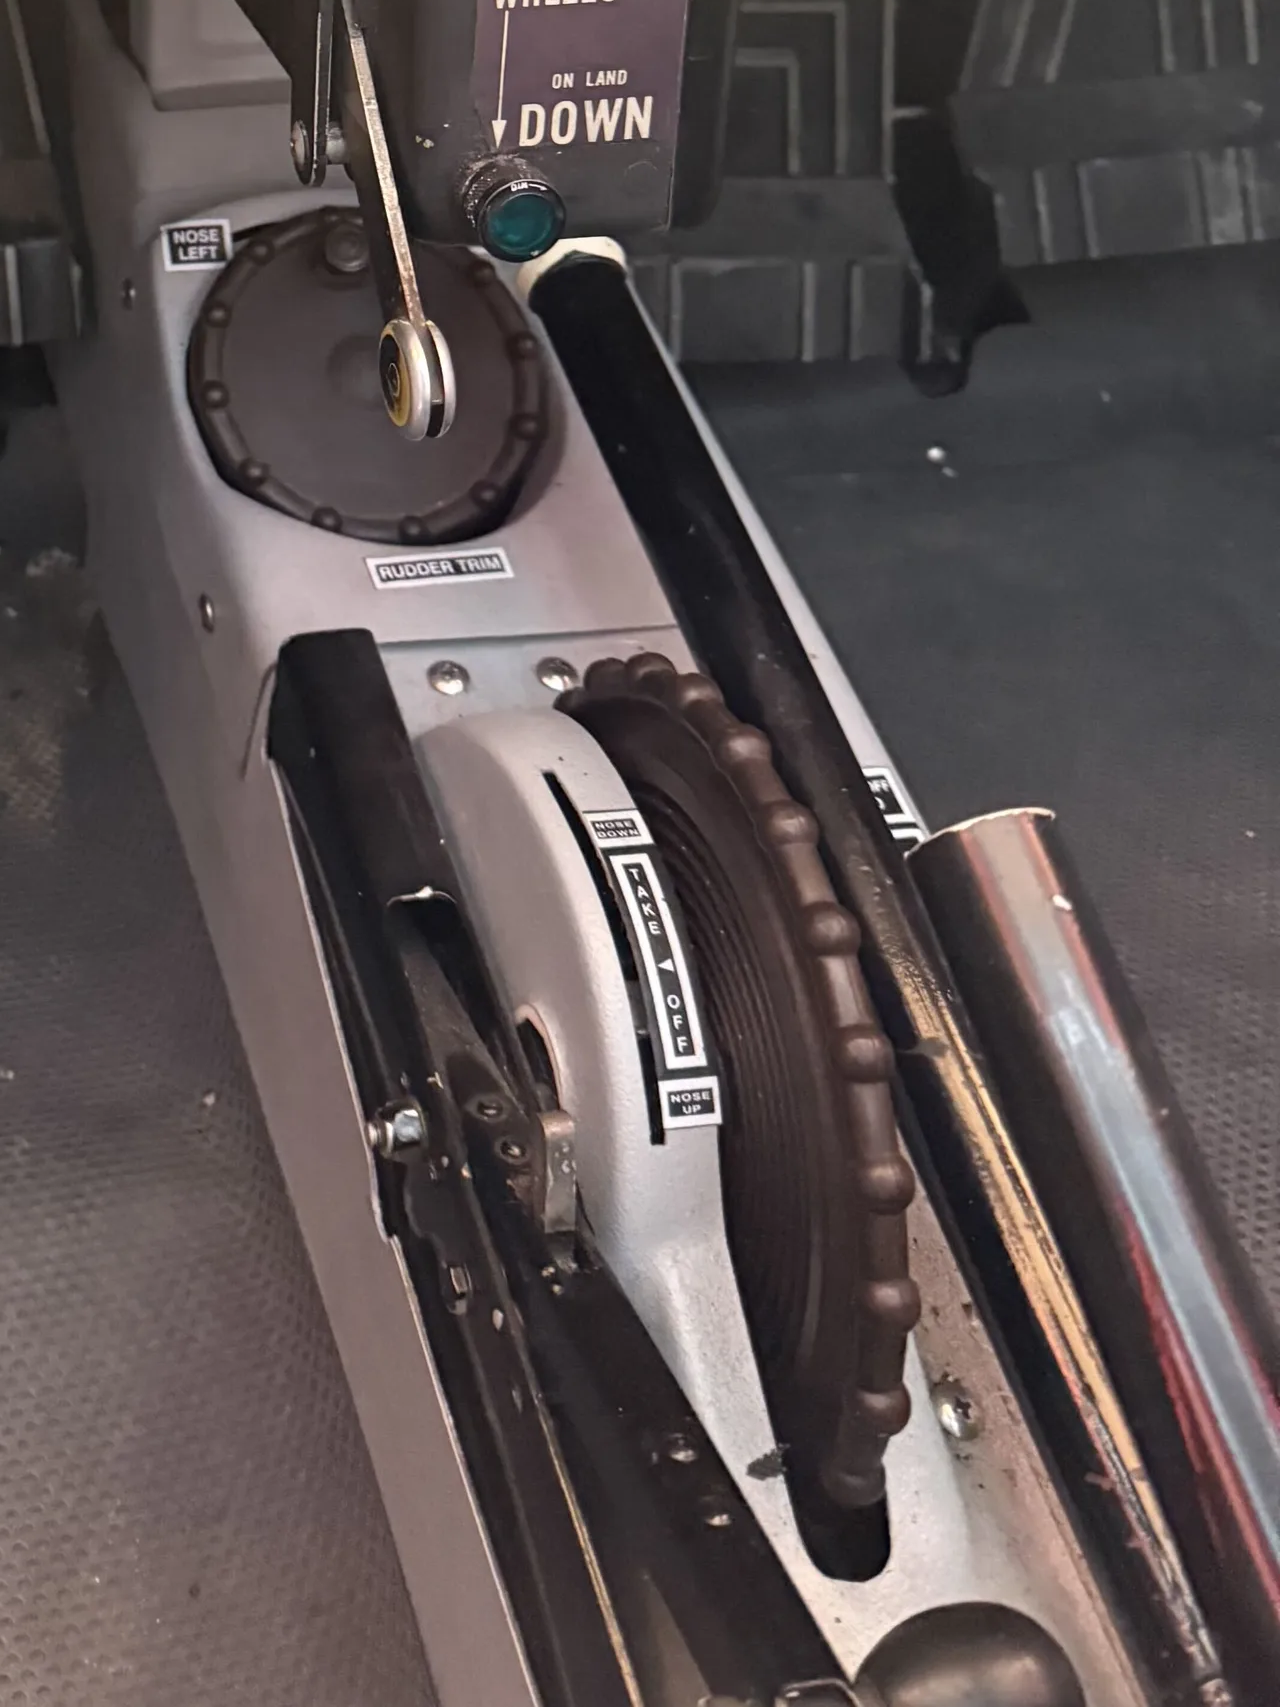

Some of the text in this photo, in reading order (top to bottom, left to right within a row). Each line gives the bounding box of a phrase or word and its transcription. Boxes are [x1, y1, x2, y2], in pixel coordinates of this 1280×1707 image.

[551, 69, 627, 89] ON LAND
[519, 96, 654, 147] DOWN
[173, 228, 220, 243] NOSE
[178, 246, 218, 261] LEFT
[378, 555, 502, 581] RUDDER TRIM
[594, 819, 634, 830] NOSE
[595, 828, 640, 838] DOWN
[628, 867, 690, 1054] TAKE OFF
[669, 1090, 712, 1103] NOSE
[682, 1104, 702, 1115] UP
